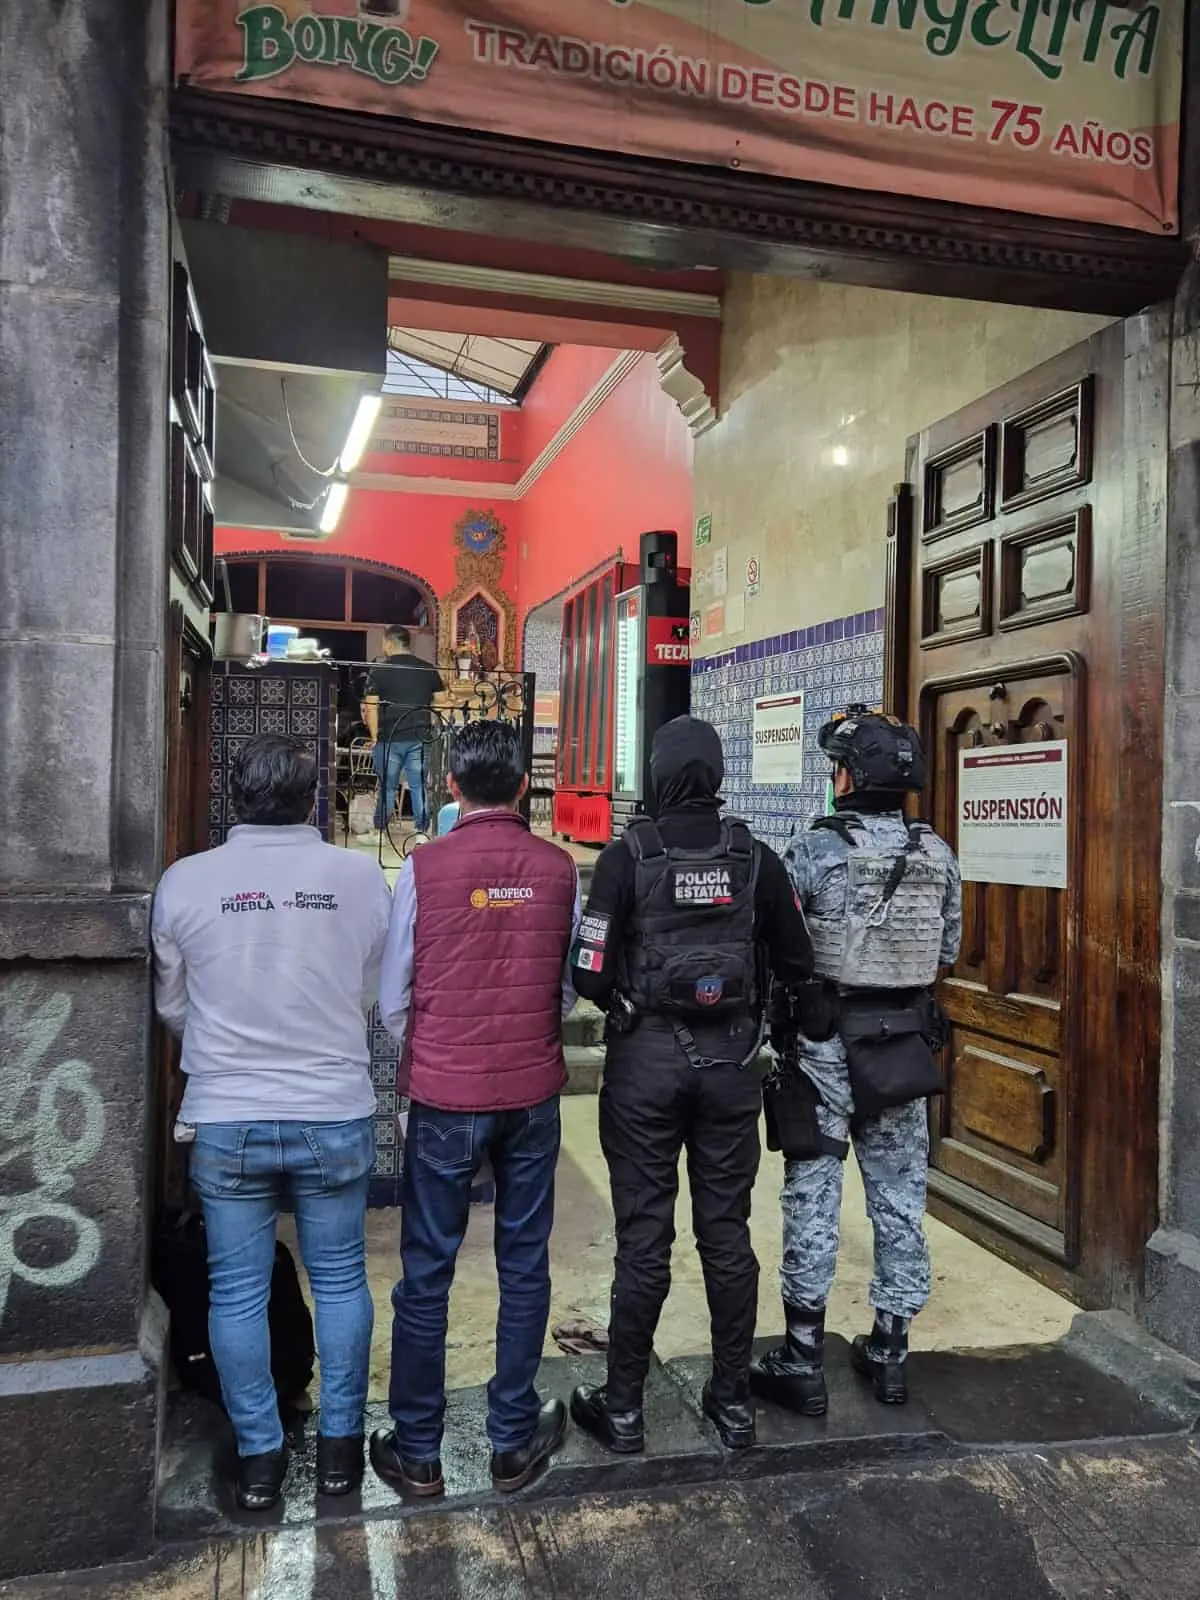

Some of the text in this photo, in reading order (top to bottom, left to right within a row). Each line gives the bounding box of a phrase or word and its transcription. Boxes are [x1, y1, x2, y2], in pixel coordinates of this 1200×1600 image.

[236, 5, 439, 83] BOING!
[469, 23, 1153, 167] TRADICIÓN DESDE HACE 75 AÑOS
[755, 721, 801, 745] SUSPENSIÓN
[963, 791, 1063, 820] SUSPENSIÓN
[675, 868, 731, 886] POLICÍA
[295, 891, 336, 902] Pensar
[488, 887, 533, 899] PROFECO
[675, 884, 732, 899] ESTATAL
[221, 899, 276, 914] PUEBLA
[295, 900, 339, 911] Grande
